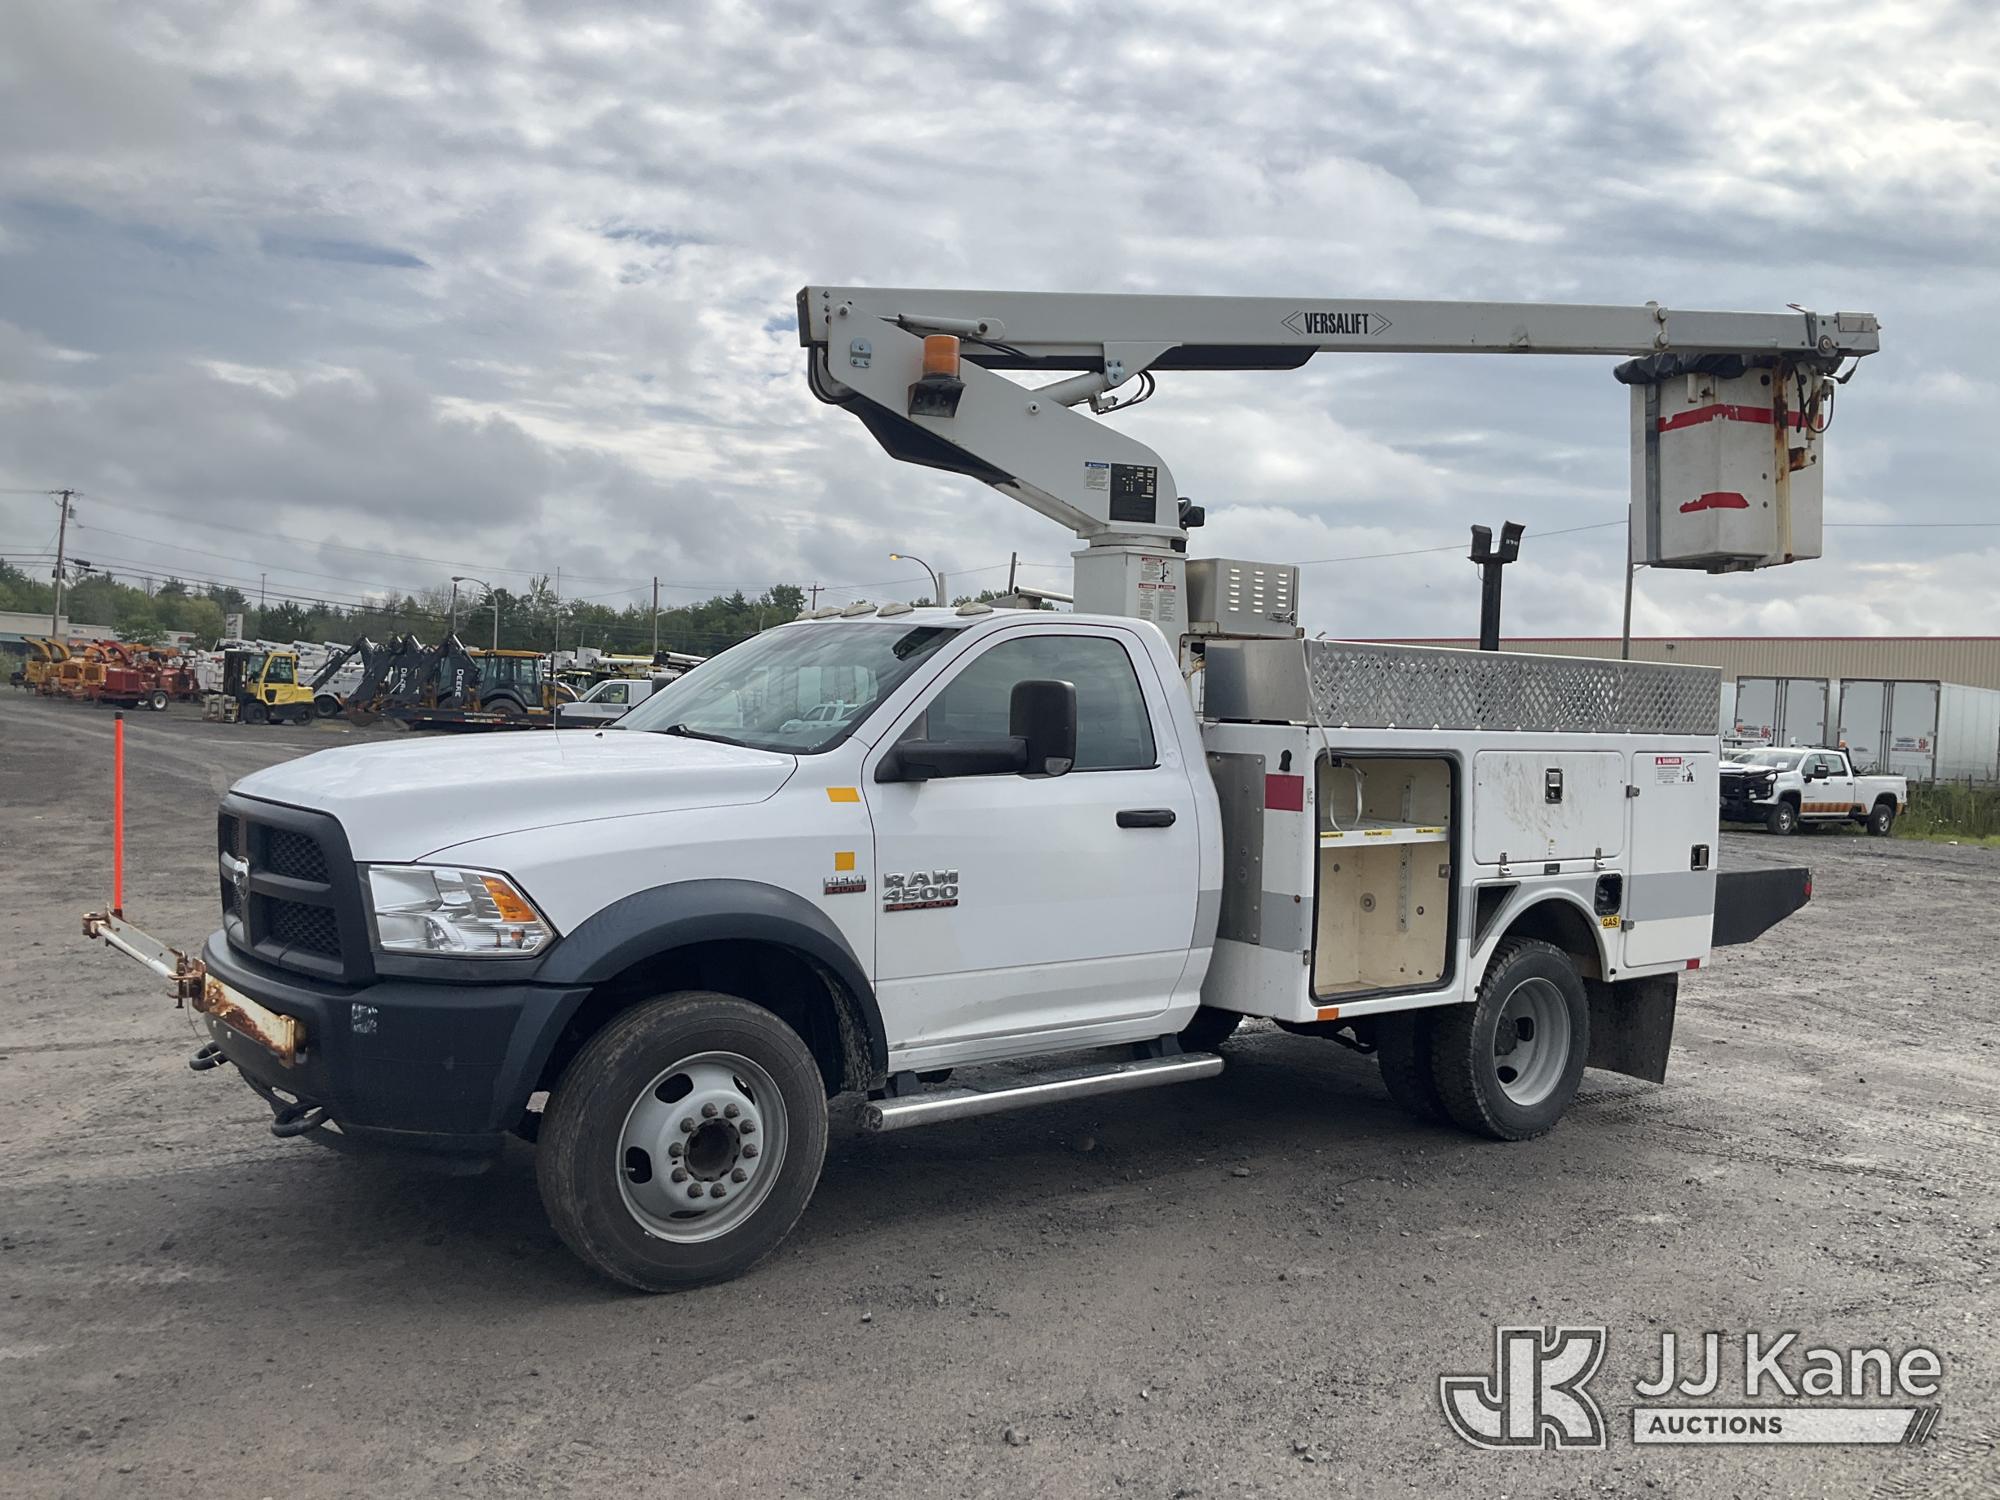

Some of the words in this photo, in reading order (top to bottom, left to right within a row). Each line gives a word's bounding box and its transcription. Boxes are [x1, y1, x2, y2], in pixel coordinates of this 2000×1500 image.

[1304, 313, 1368, 334] VERSALIFT
[454, 668, 465, 698] DEERE
[883, 869, 959, 888] RAM
[882, 884, 959, 902] 4500
[1602, 917, 1618, 927] GAS
